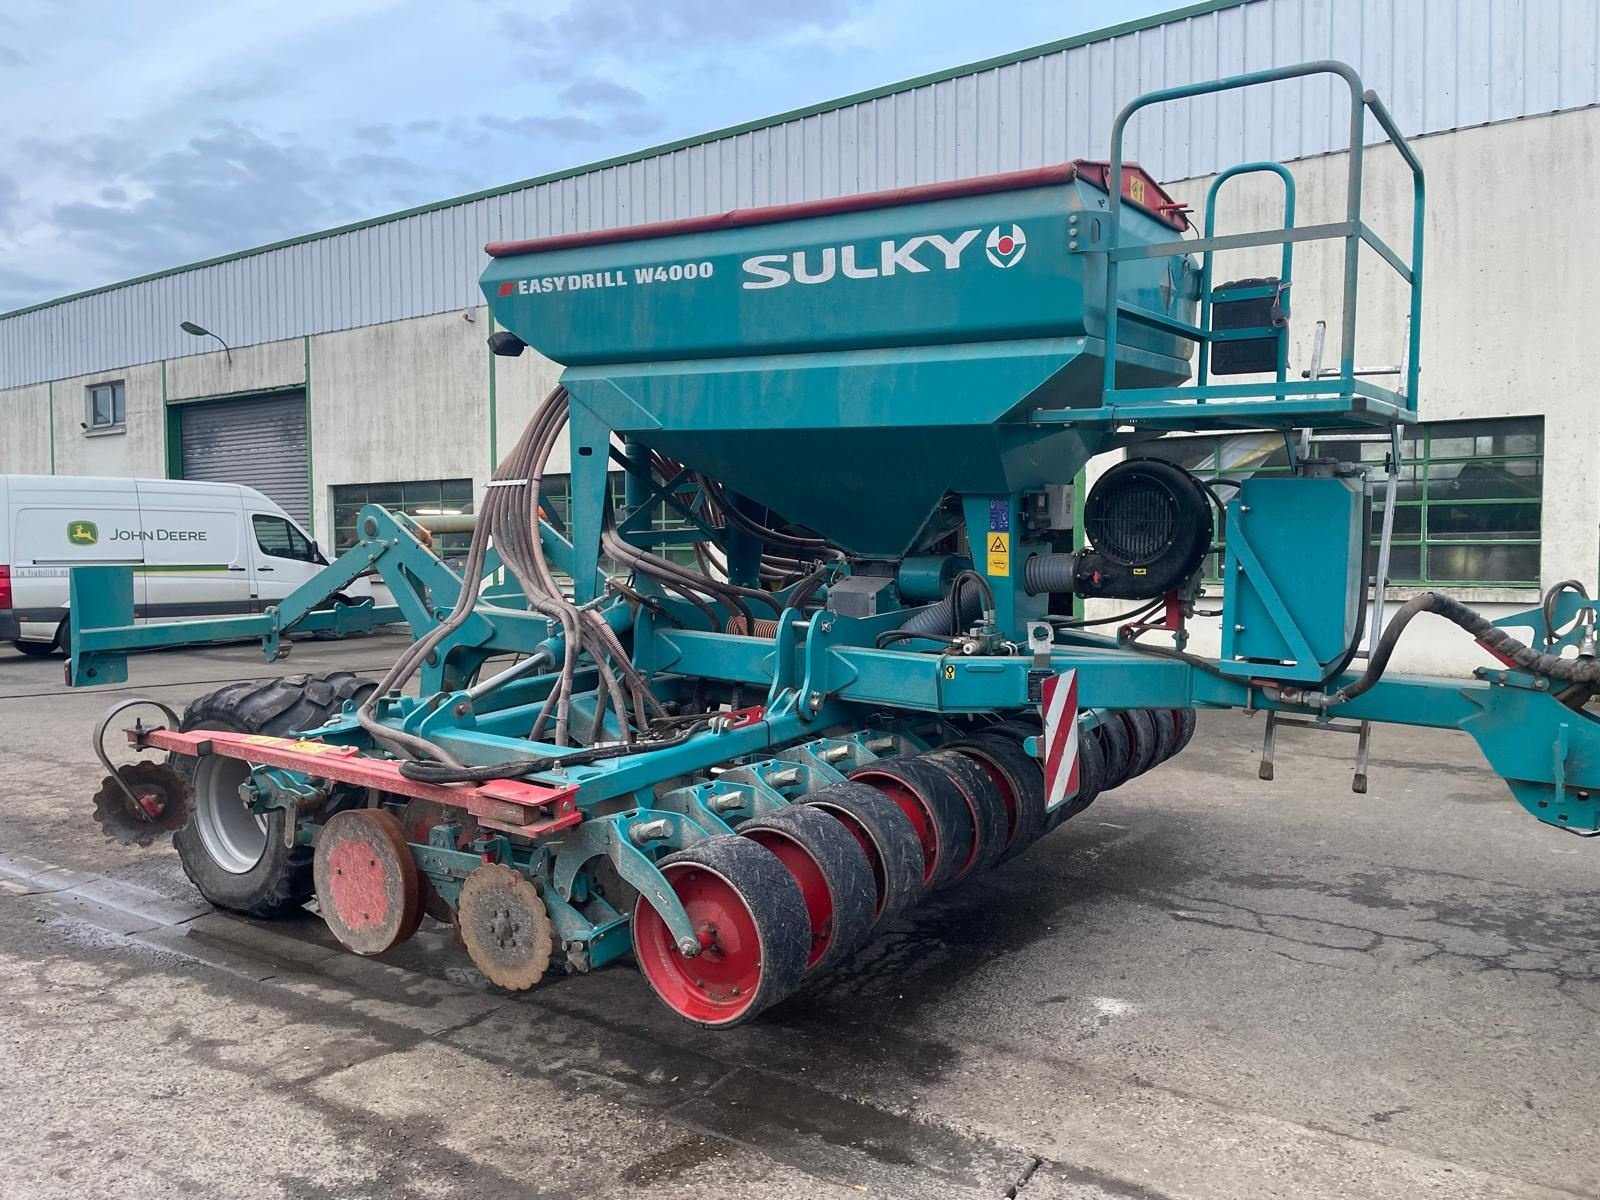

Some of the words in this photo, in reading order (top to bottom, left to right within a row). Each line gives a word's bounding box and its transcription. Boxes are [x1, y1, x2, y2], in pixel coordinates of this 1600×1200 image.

[742, 228, 983, 290] SULKY
[518, 270, 628, 295] EASYDRILL
[634, 261, 714, 285] W4000
[109, 528, 154, 541] JOHN
[156, 529, 208, 541] DEERE
